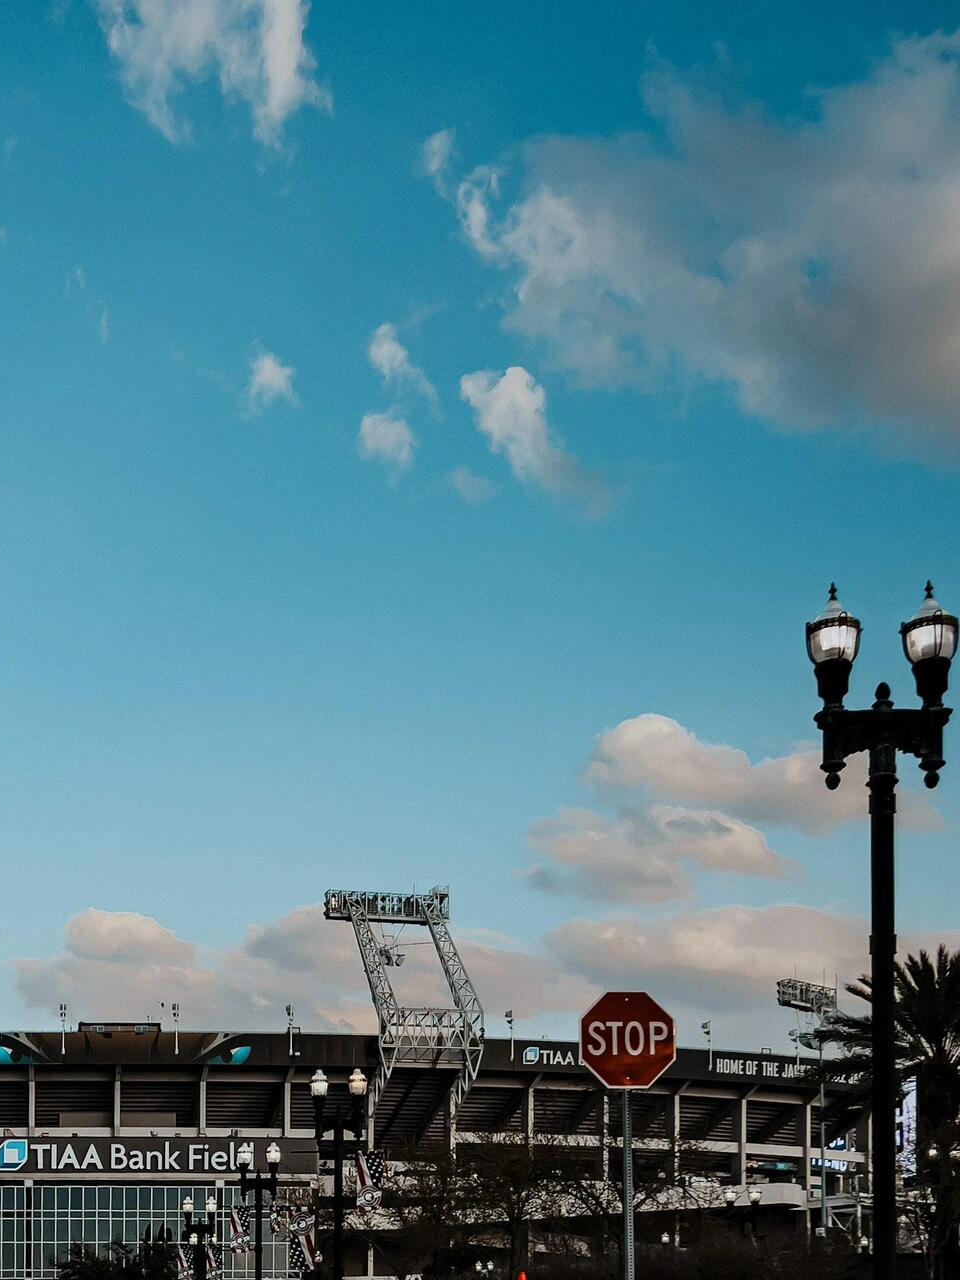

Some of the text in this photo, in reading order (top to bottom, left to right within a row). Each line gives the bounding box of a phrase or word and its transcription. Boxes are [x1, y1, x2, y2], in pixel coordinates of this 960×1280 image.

[587, 1020, 669, 1056] STOP
[540, 1050, 575, 1066] TIAA
[716, 1058, 744, 1075] HOME
[745, 1060, 759, 1076] OF
[761, 1061, 779, 1077] THE
[30, 1143, 104, 1171] TIAA
[110, 1141, 181, 1171] Bank
